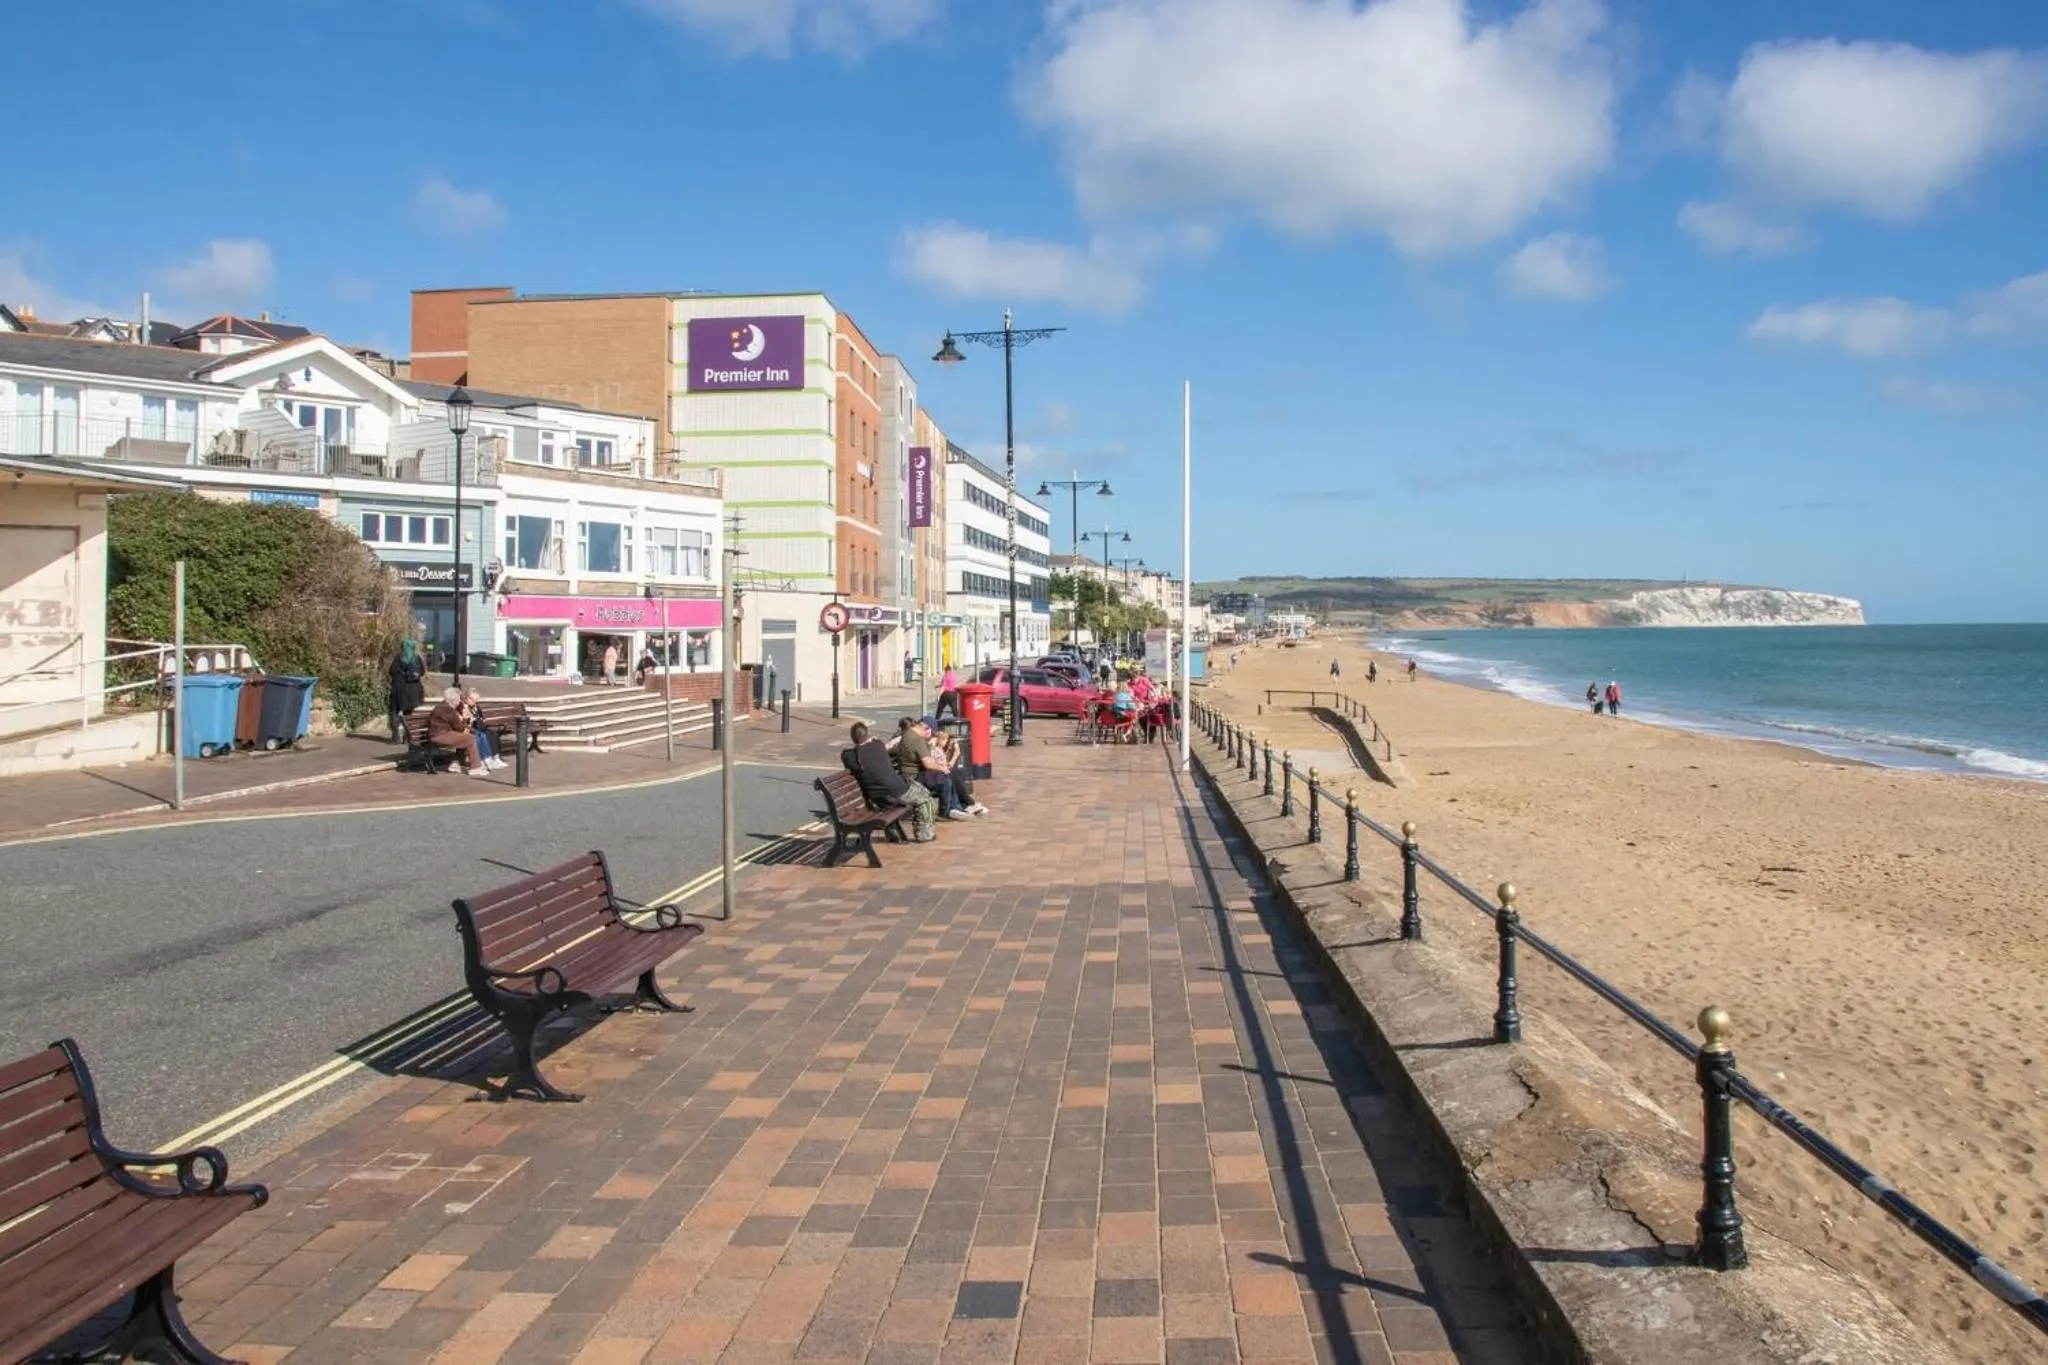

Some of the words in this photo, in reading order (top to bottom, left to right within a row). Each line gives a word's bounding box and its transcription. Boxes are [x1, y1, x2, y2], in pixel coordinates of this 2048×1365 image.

[704, 367, 764, 383] Premier
[766, 366, 789, 381] Inn
[915, 470, 925, 503] Premier
[915, 505, 925, 519] Inn
[418, 566, 456, 581] Dessert
